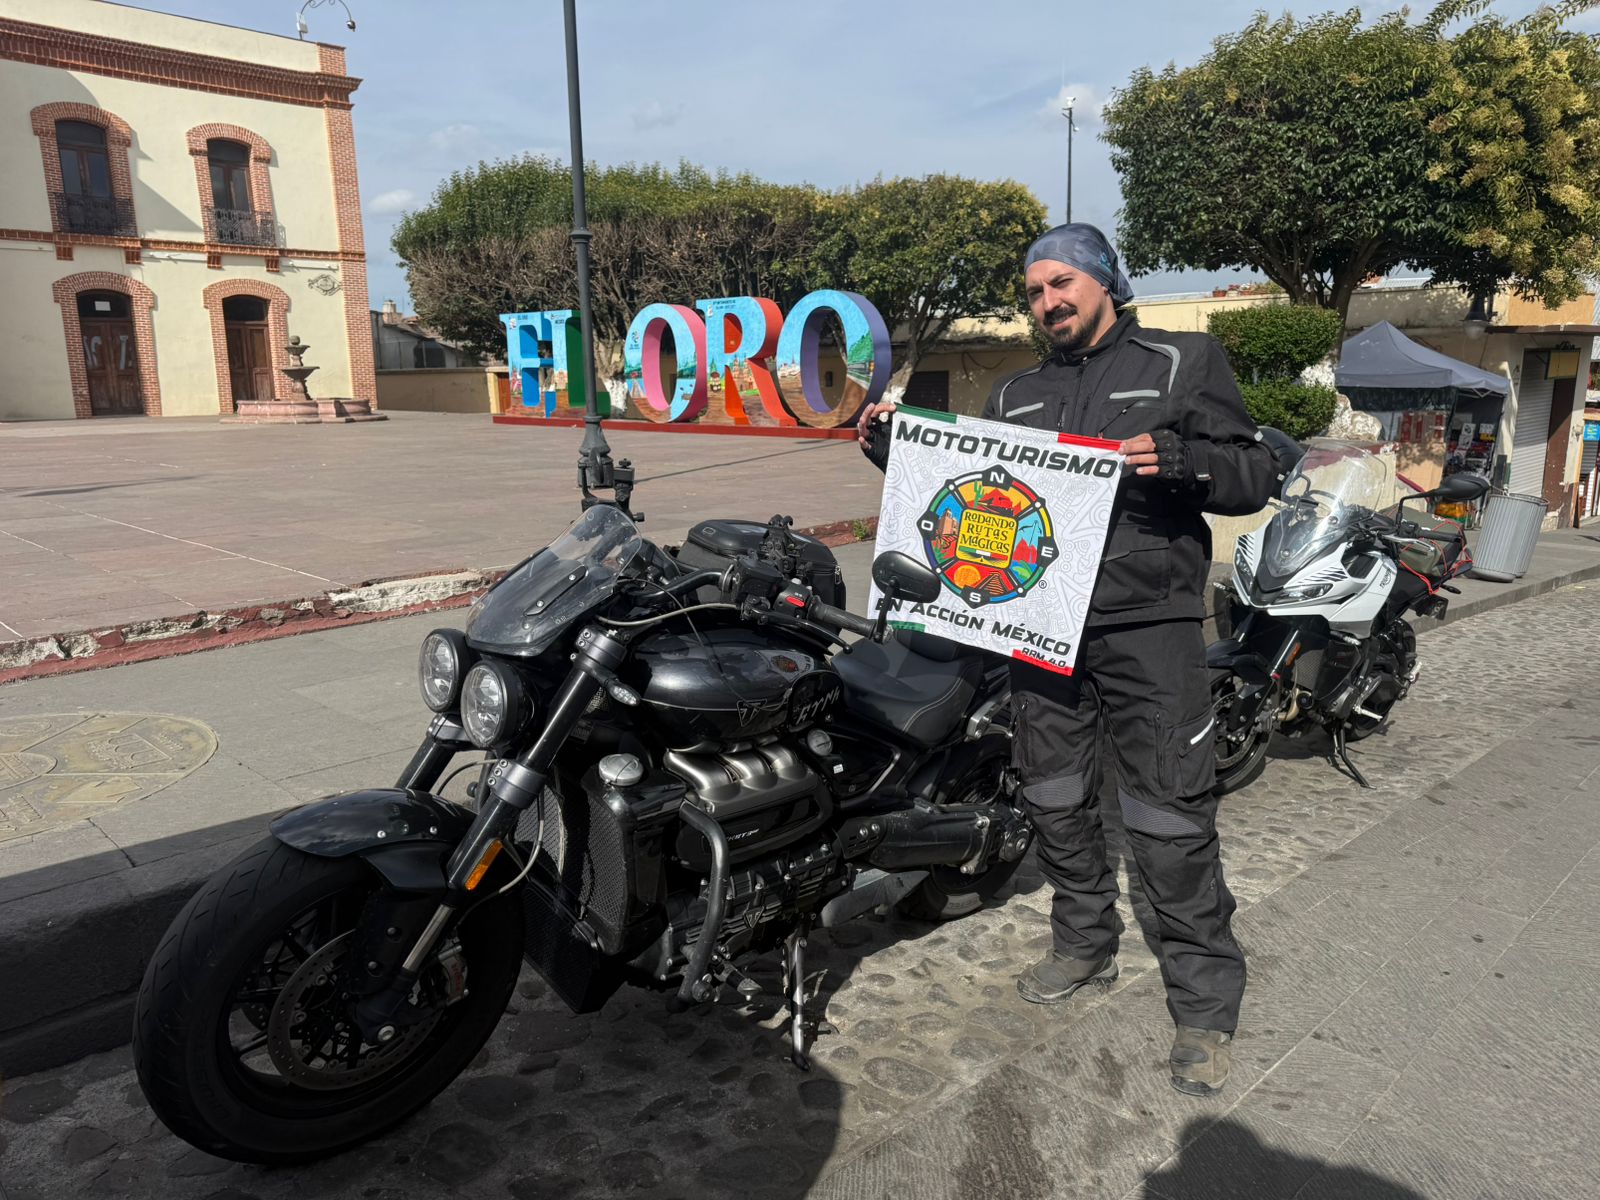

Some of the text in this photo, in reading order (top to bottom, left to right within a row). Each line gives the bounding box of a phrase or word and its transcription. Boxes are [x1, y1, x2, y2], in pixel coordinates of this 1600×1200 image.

[624, 289, 892, 429] ORO
[896, 420, 1118, 478] MOTOTURISMO
[990, 472, 1005, 483] N
[921, 521, 933, 531] O
[1041, 546, 1054, 558] E
[969, 592, 982, 603] S
[909, 602, 985, 630] ACCIÓN
[991, 622, 1072, 656] MÉXICO
[1048, 657, 1067, 668] 4.0
